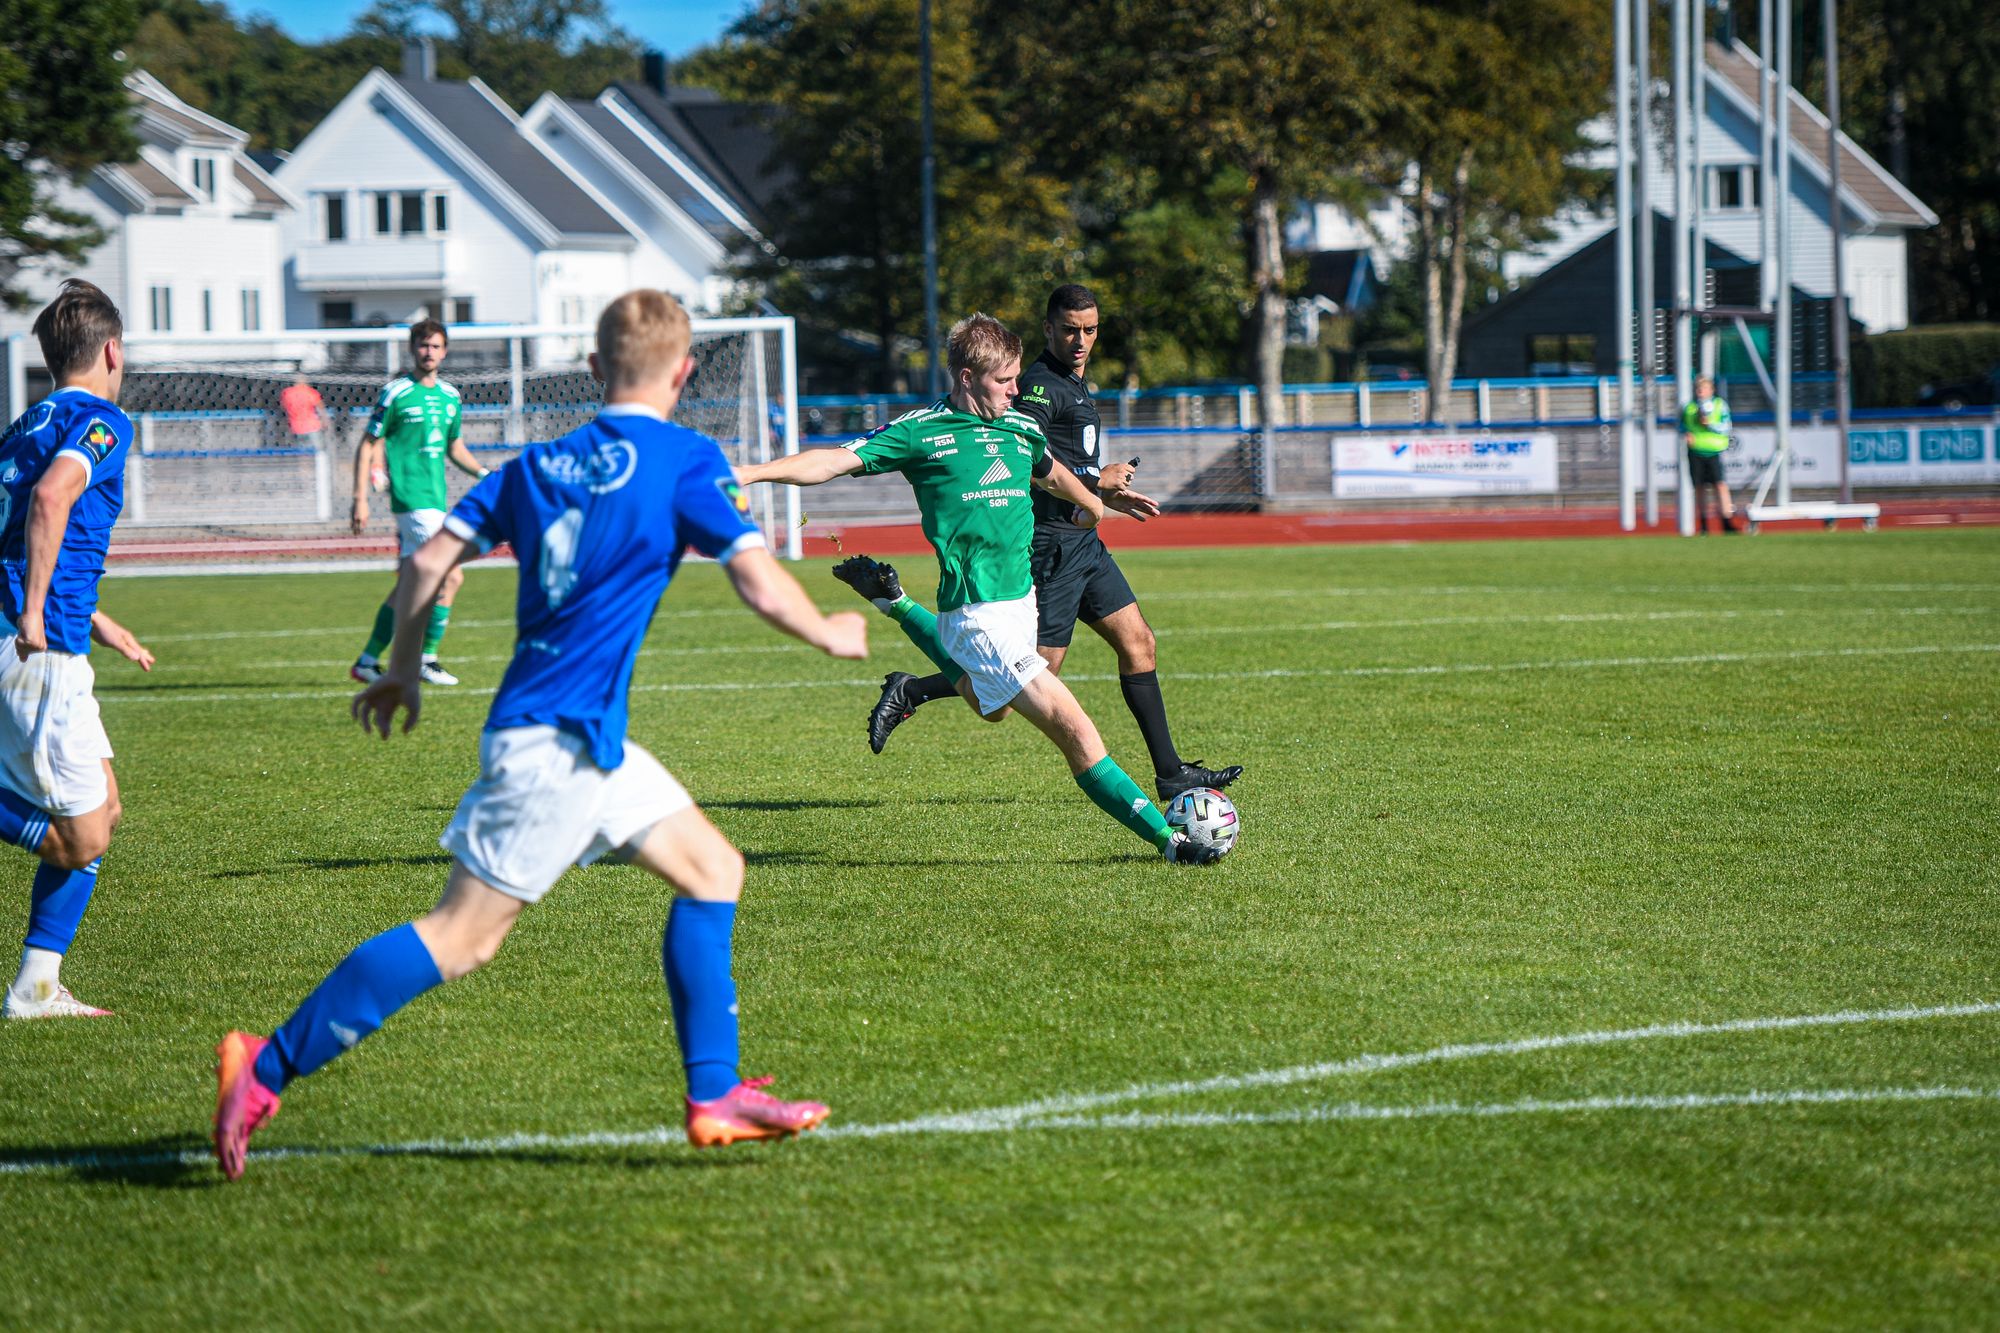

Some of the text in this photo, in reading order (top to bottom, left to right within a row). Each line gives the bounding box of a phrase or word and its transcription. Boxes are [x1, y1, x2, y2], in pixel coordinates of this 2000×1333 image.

[1022, 395, 1051, 406] unisport
[934, 437, 956, 447] RSM
[1848, 434, 1903, 460] DNB
[1925, 432, 1980, 459] DNB
[961, 488, 1027, 502] SPAREBANKEN
[989, 498, 1009, 508] SØR
